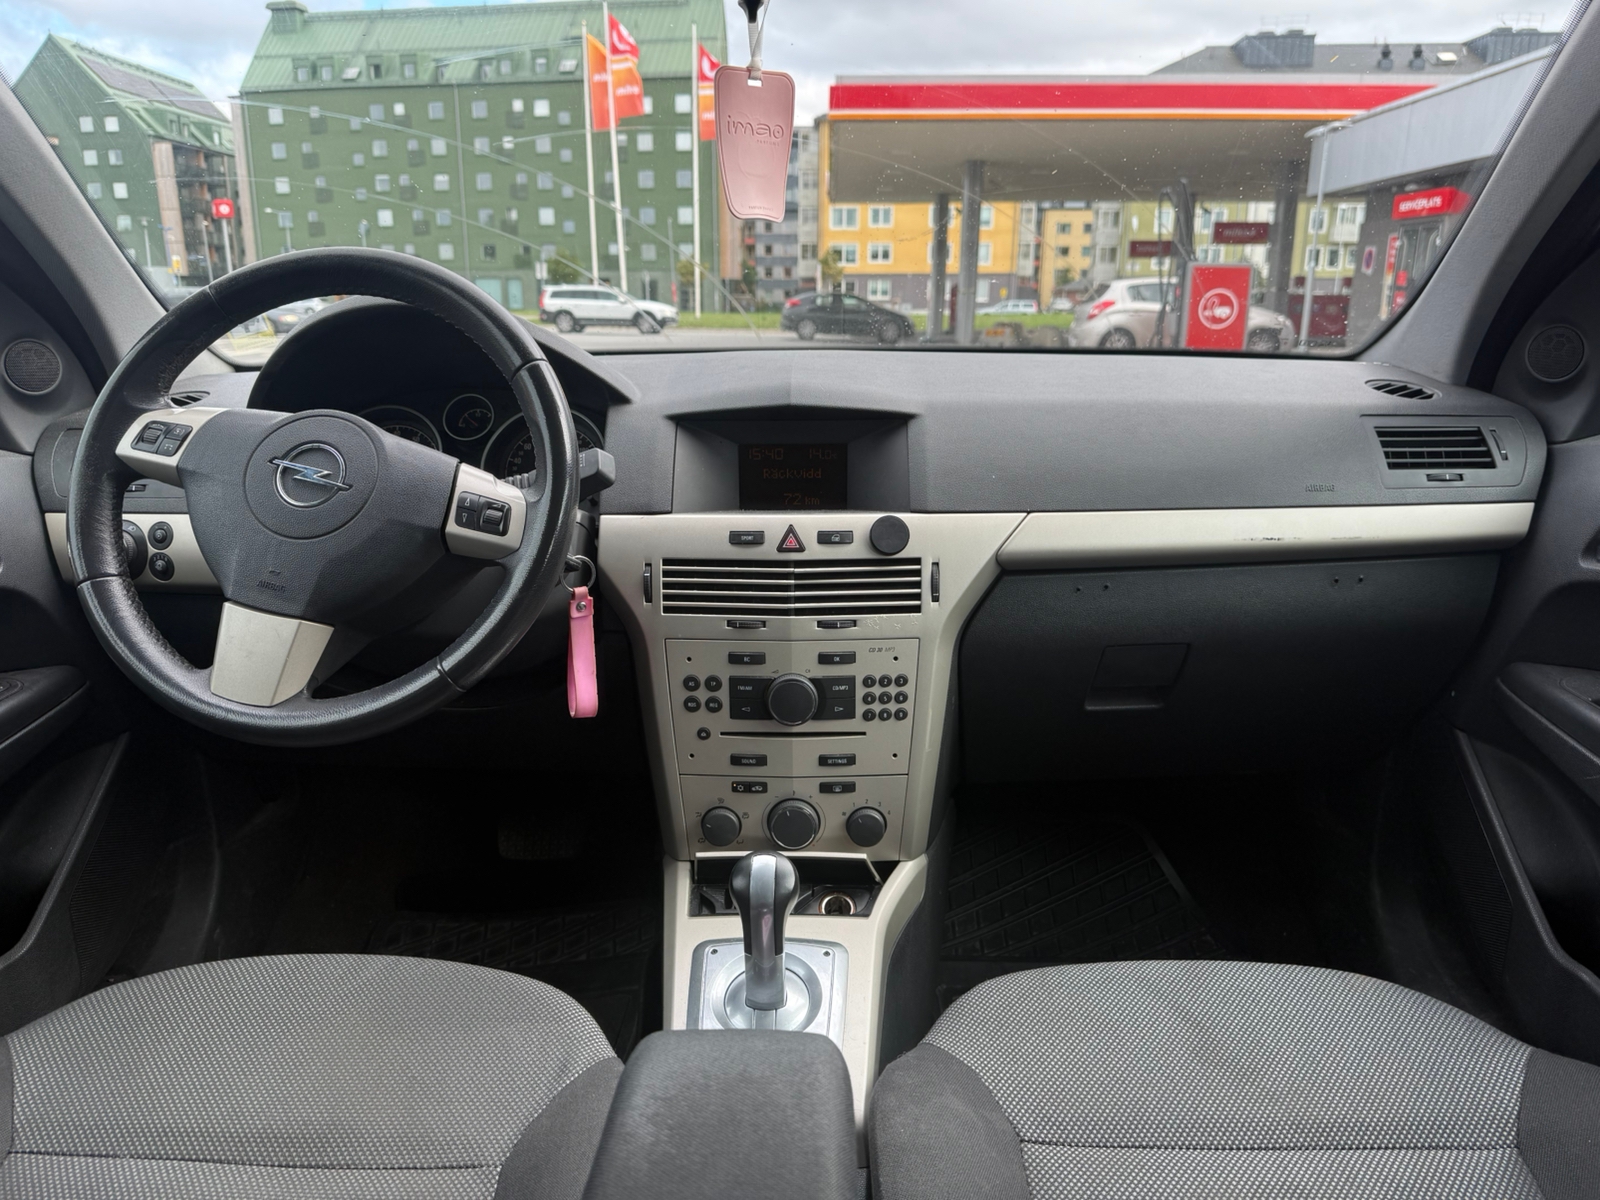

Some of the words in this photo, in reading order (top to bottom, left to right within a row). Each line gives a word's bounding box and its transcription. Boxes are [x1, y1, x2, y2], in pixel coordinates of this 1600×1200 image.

[1398, 195, 1443, 213] SERVICEPLATS
[748, 447, 784, 460] 15:40
[763, 468, 822, 479] Räckvidd
[783, 493, 802, 505] 72
[804, 496, 820, 505] km
